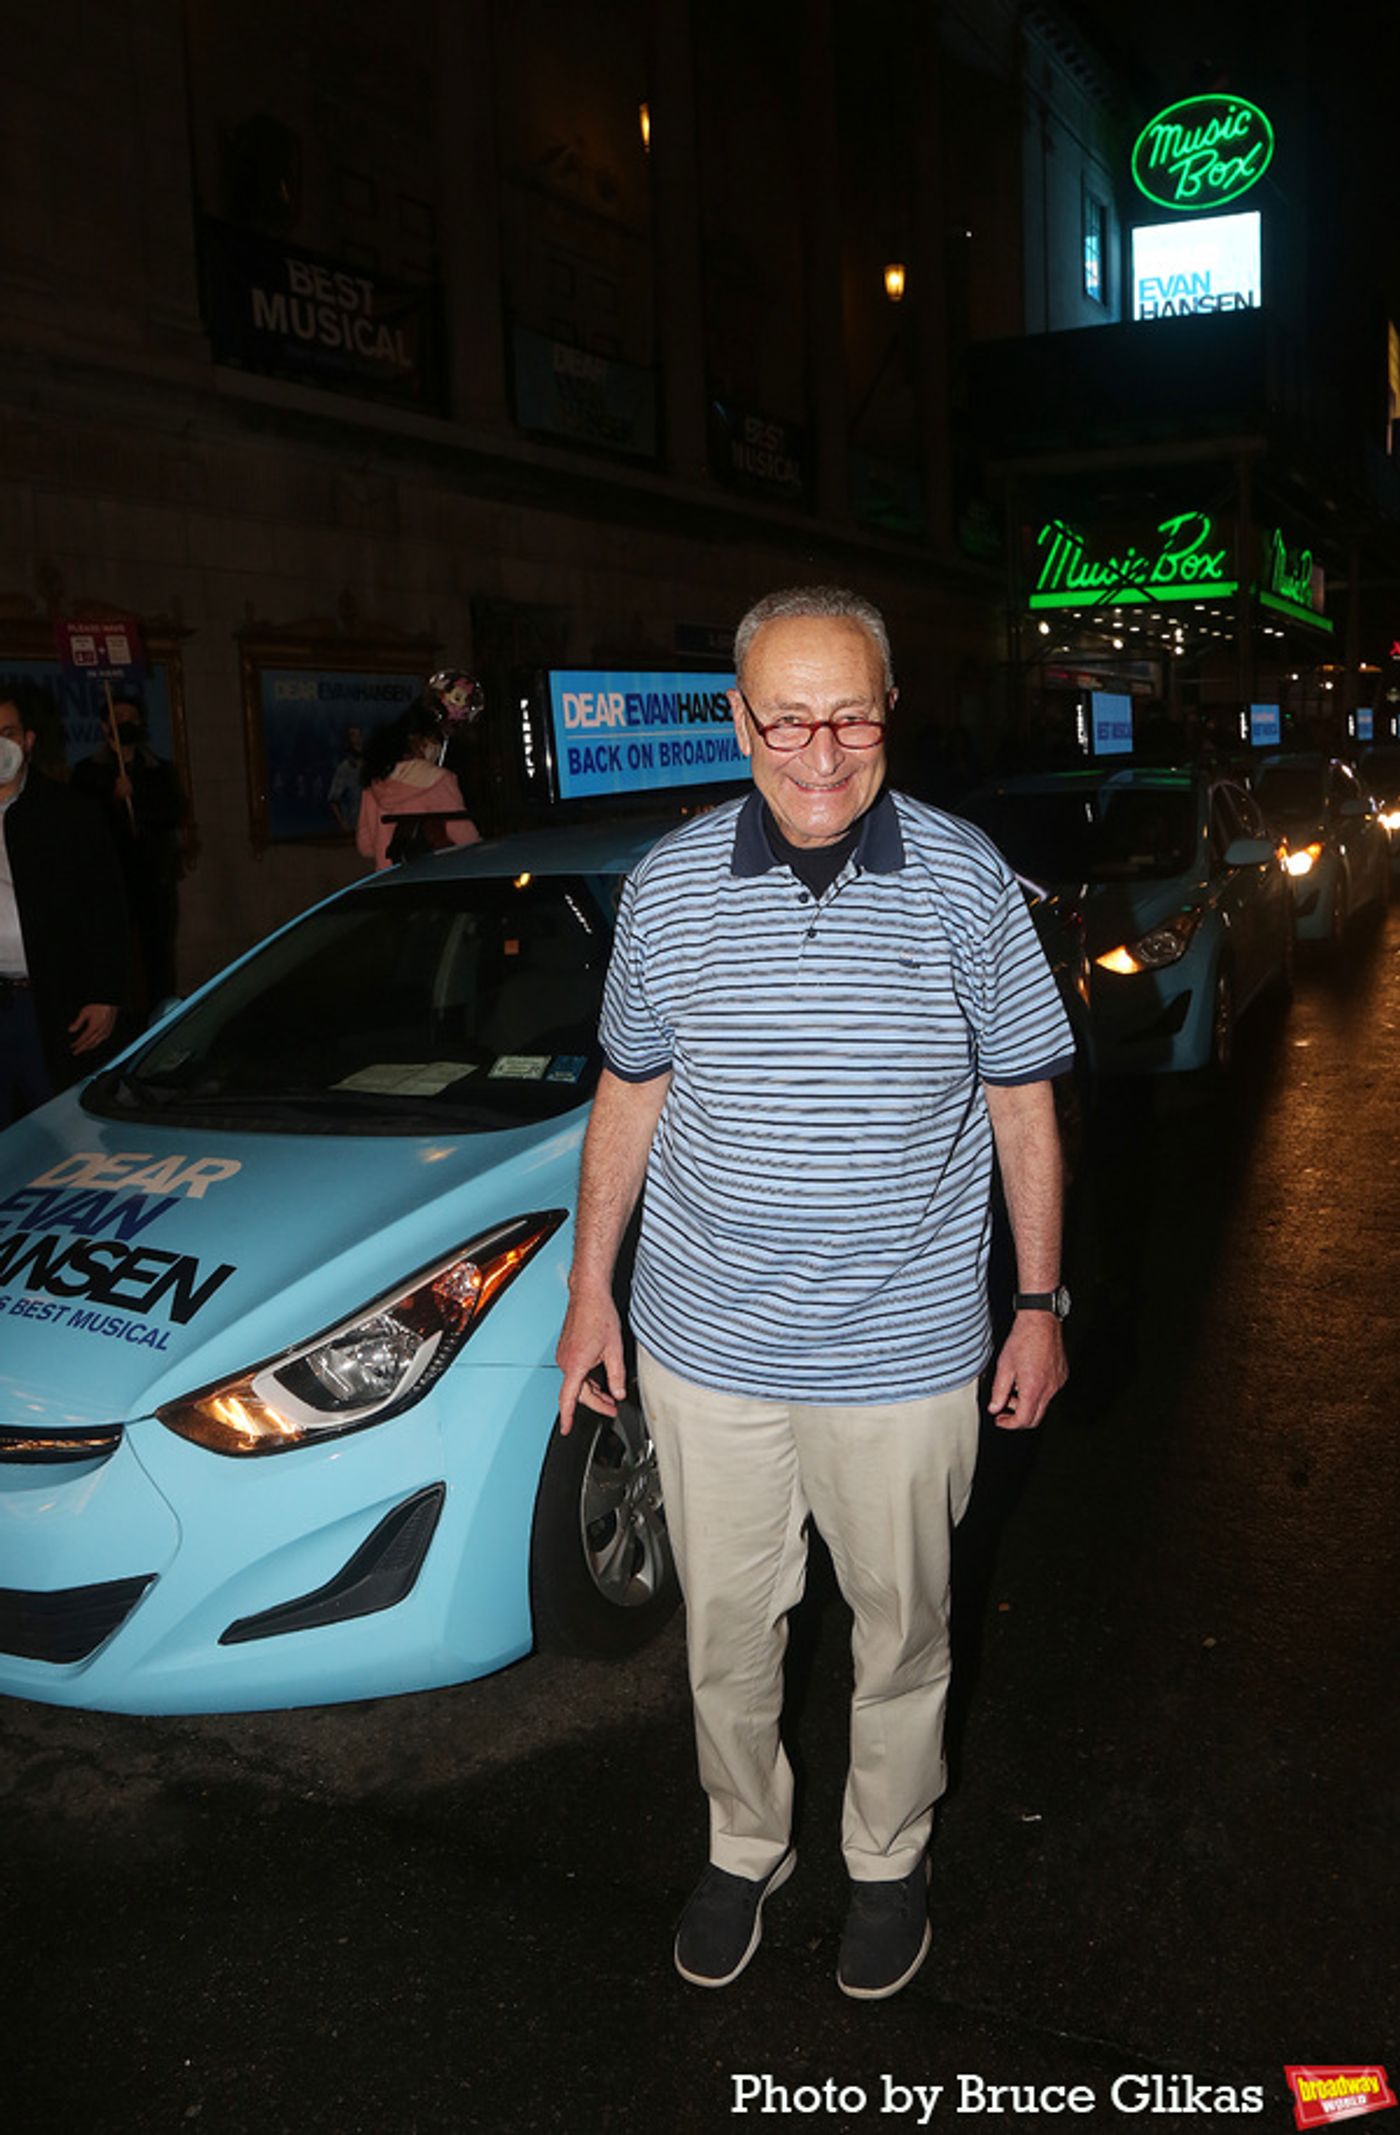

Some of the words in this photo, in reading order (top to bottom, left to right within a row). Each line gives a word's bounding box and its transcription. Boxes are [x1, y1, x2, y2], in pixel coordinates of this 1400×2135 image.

[1149, 105, 1252, 168] Music
[1168, 141, 1263, 200] Box
[284, 256, 374, 317] BEST
[1139, 270, 1211, 301] EVAN
[250, 287, 413, 368] MUSICAL
[1038, 519, 1149, 591] Music
[1149, 511, 1226, 583] Box
[567, 744, 623, 775] BACK
[627, 743, 654, 770] ON
[660, 737, 748, 767] BROADWA
[27, 1152, 242, 1198] DEAR
[0, 1233, 238, 1325] ANSEN
[8, 1298, 71, 1323] BEST
[66, 1309, 171, 1351] MUSICAL
